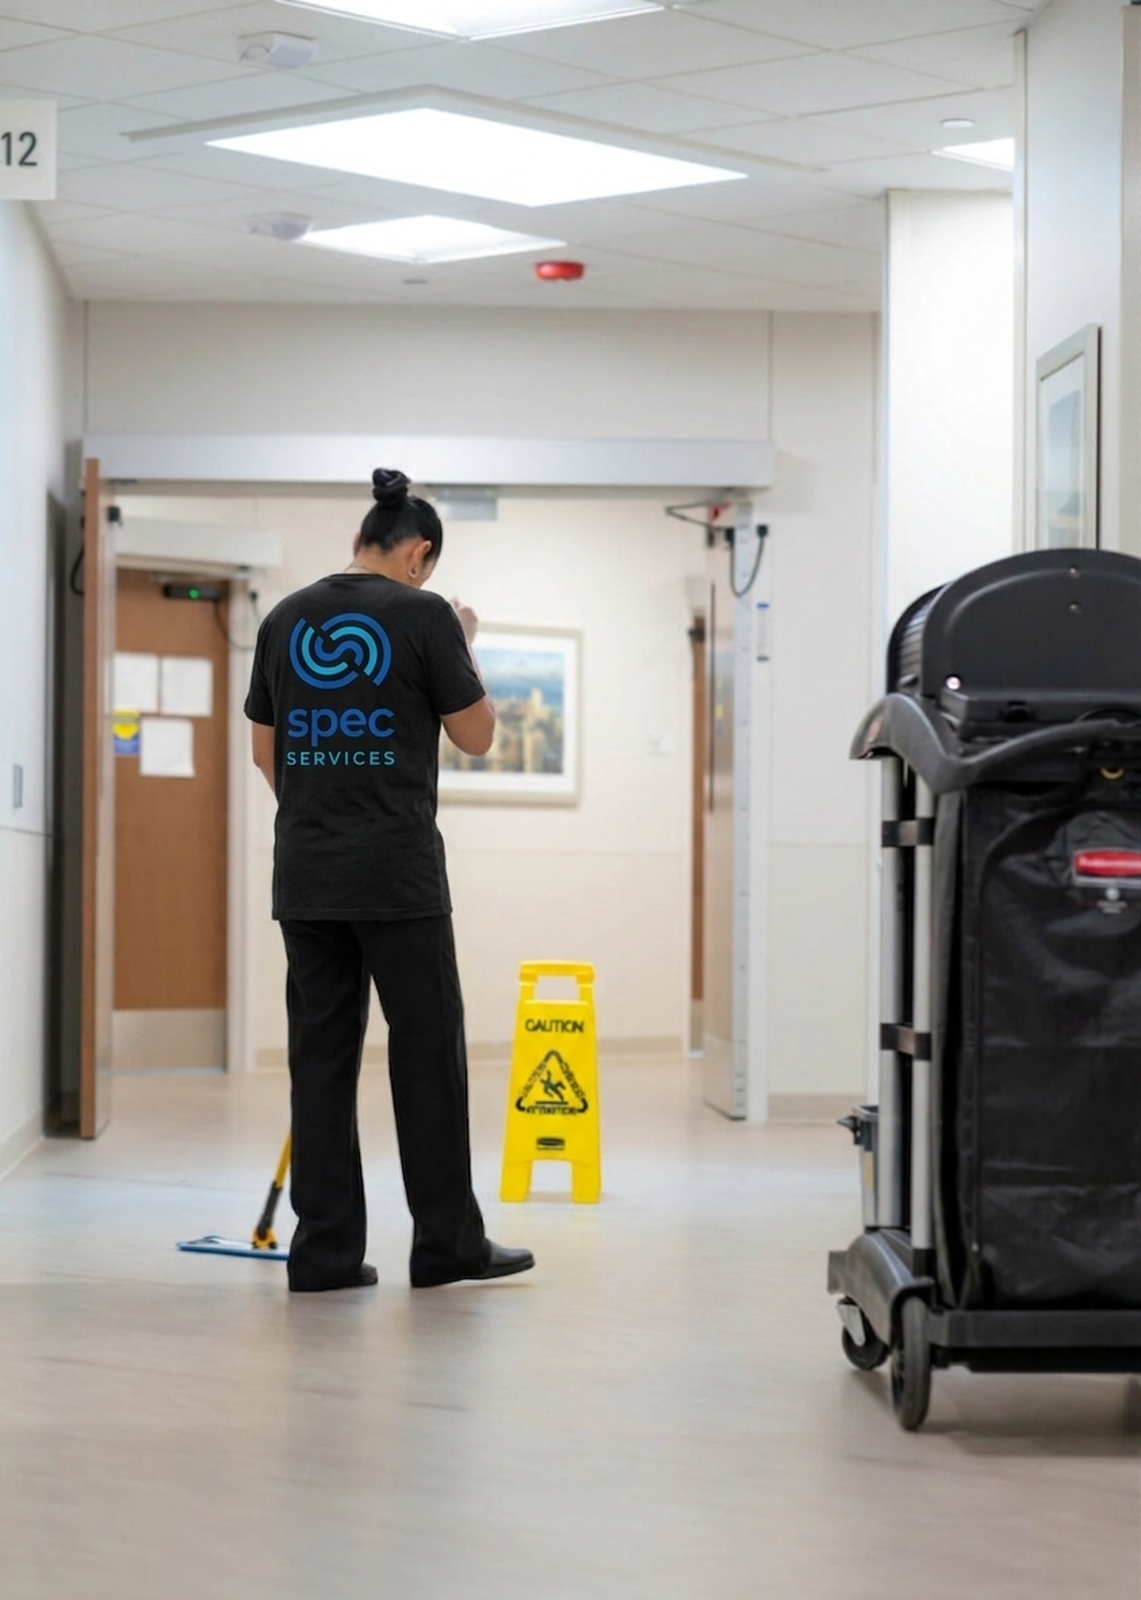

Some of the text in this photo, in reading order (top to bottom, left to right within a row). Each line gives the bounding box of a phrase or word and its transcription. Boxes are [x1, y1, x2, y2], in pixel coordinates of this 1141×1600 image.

[0, 131, 38, 166] 12
[287, 708, 395, 747] spec
[286, 751, 395, 766] SERVICES
[525, 1018, 584, 1033] CAUTION
